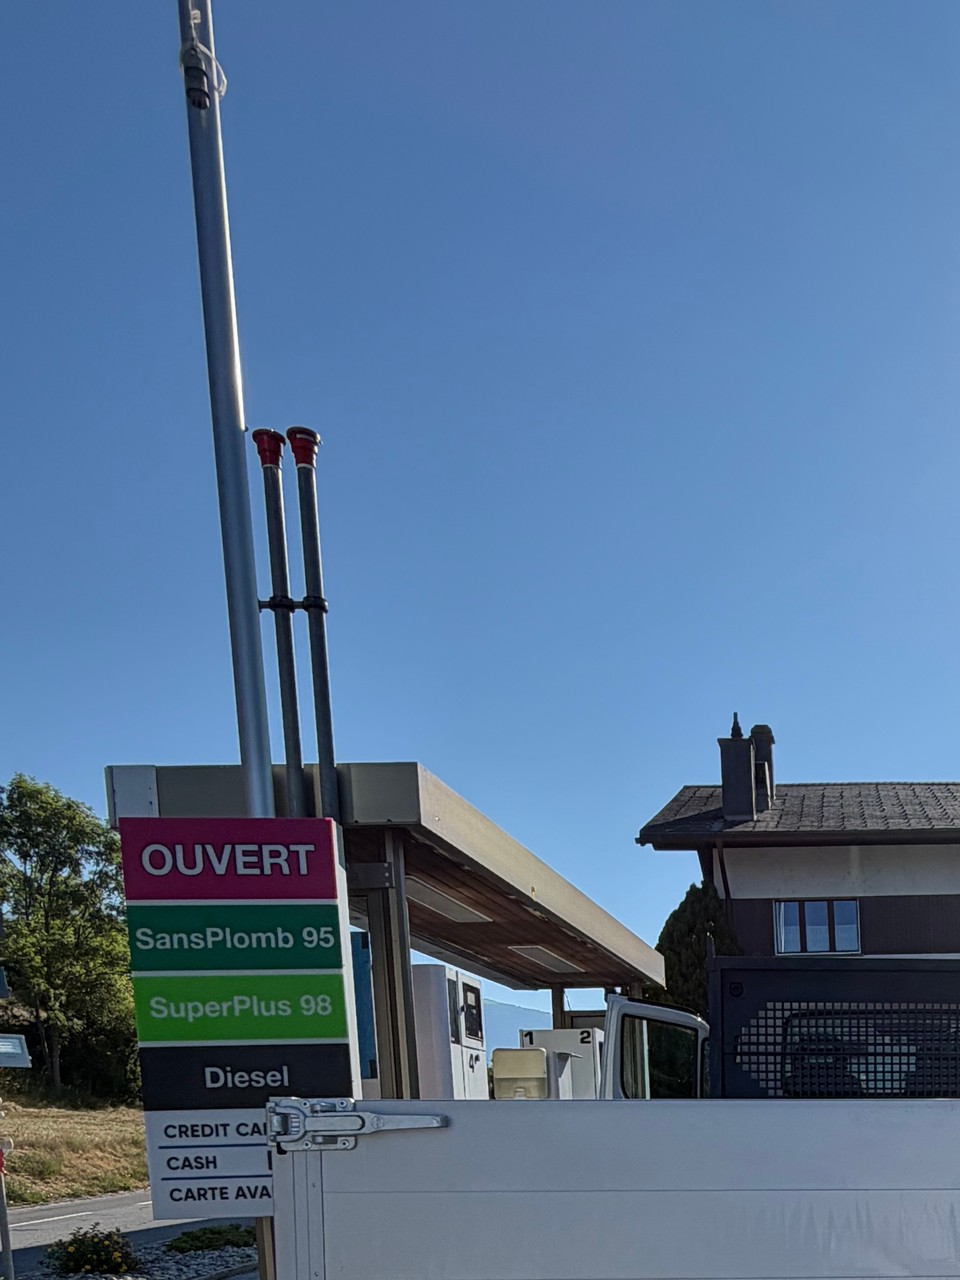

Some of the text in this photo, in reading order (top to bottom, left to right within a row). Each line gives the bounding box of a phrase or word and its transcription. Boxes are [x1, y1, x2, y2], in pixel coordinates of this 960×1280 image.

[141, 843, 315, 876] OUVERT
[135, 926, 335, 950] SansPlomb 95
[150, 994, 332, 1022] SuperPlus 98
[524, 1031, 534, 1045] 1
[579, 1030, 592, 1044] 2
[204, 1065, 289, 1089] Diesel
[164, 1123, 230, 1138] CREDIT
[166, 1156, 217, 1170] CASH
[169, 1186, 229, 1202] CARTE
